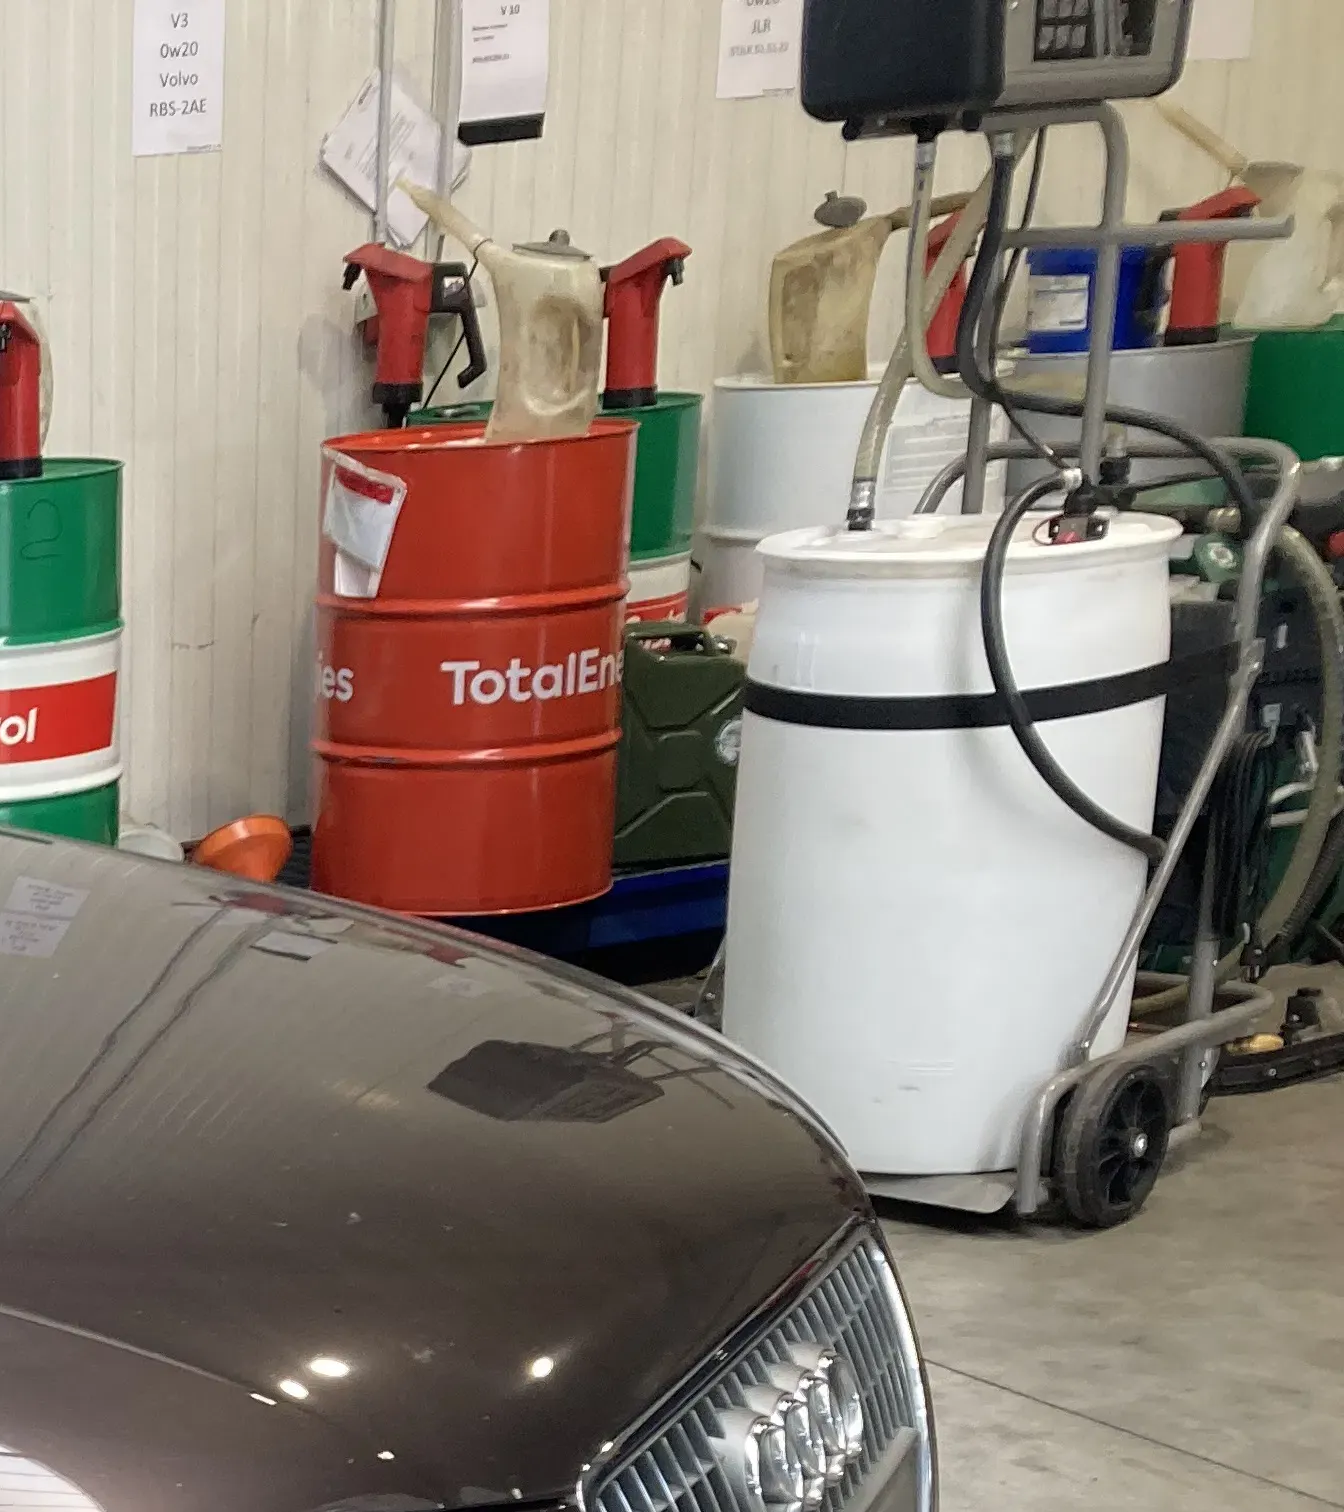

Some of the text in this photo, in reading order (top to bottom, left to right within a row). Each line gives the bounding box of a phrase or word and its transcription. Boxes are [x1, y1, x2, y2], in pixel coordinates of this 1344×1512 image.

[171, 12, 189, 28] V3
[160, 41, 199, 59] 0w20
[159, 70, 199, 88] Volvo
[149, 98, 207, 118] RBS-2AE
